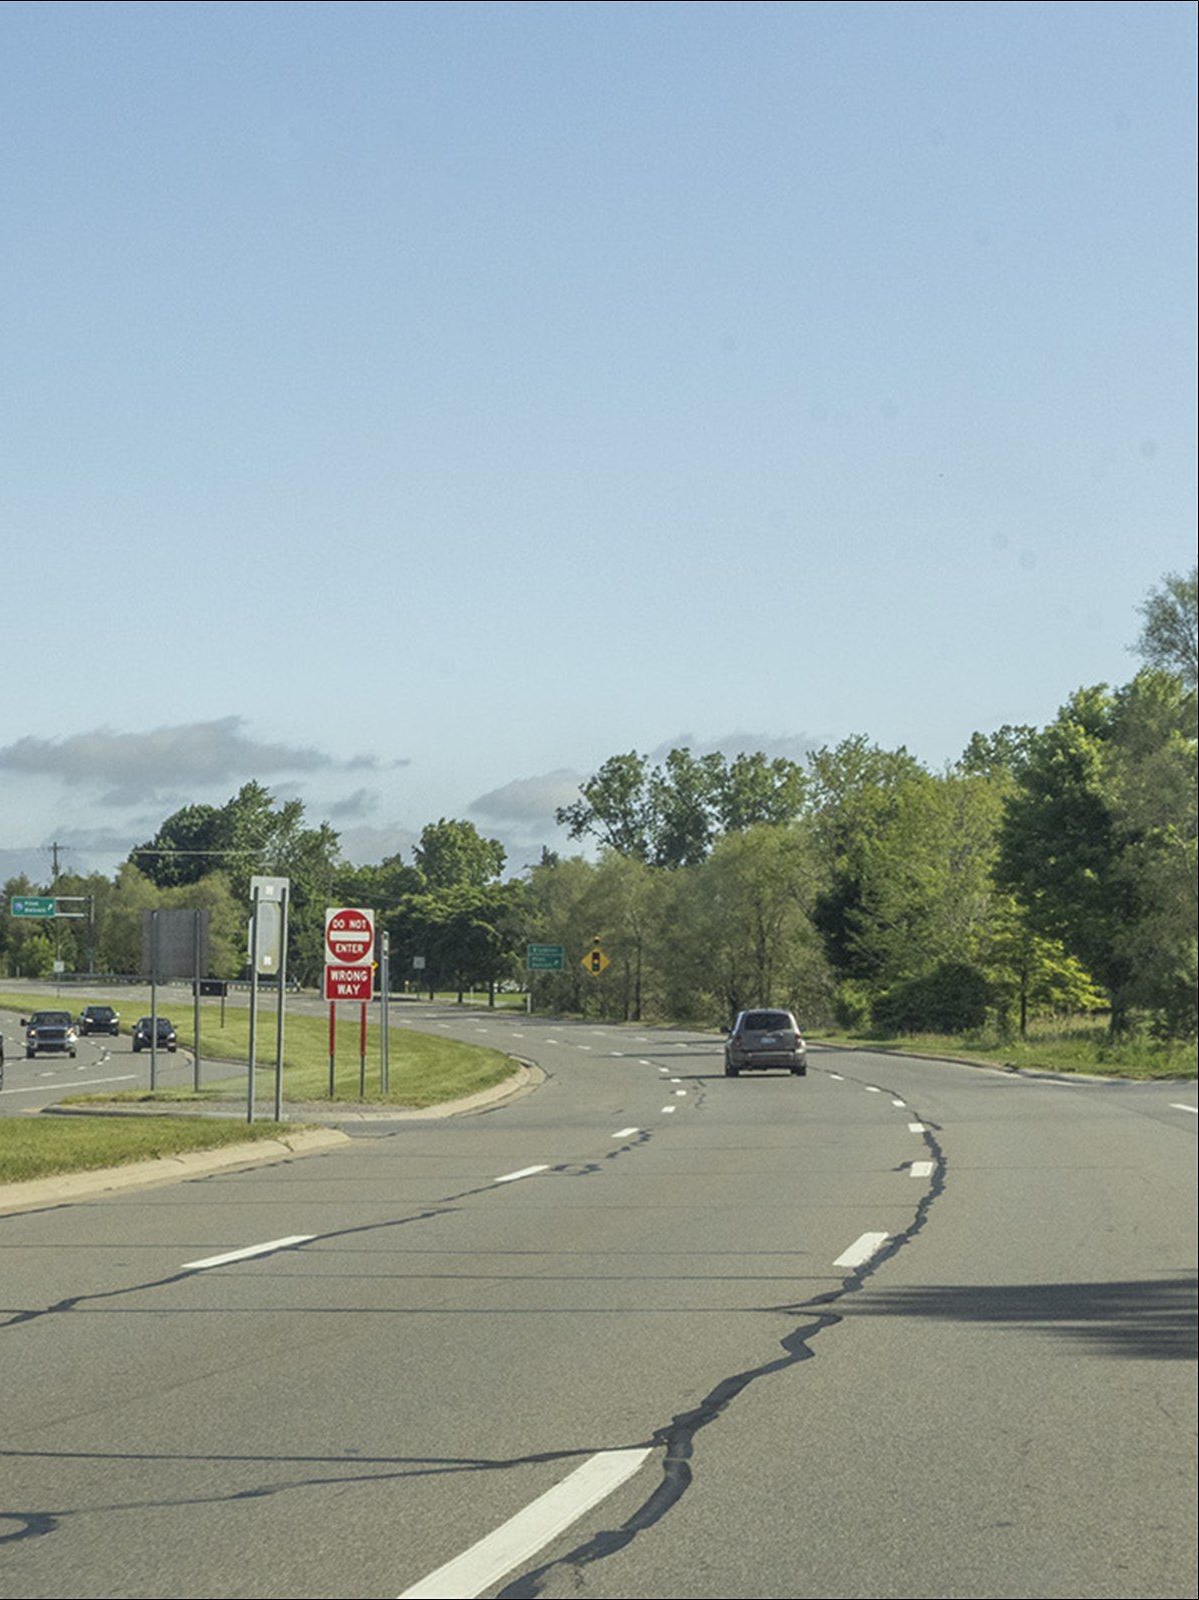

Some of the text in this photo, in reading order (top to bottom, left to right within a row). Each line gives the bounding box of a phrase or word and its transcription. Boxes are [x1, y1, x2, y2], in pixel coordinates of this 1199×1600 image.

[332, 919, 367, 929] DO NOT
[335, 943, 364, 953] ENTER
[330, 970, 368, 995] WRONG WAY
